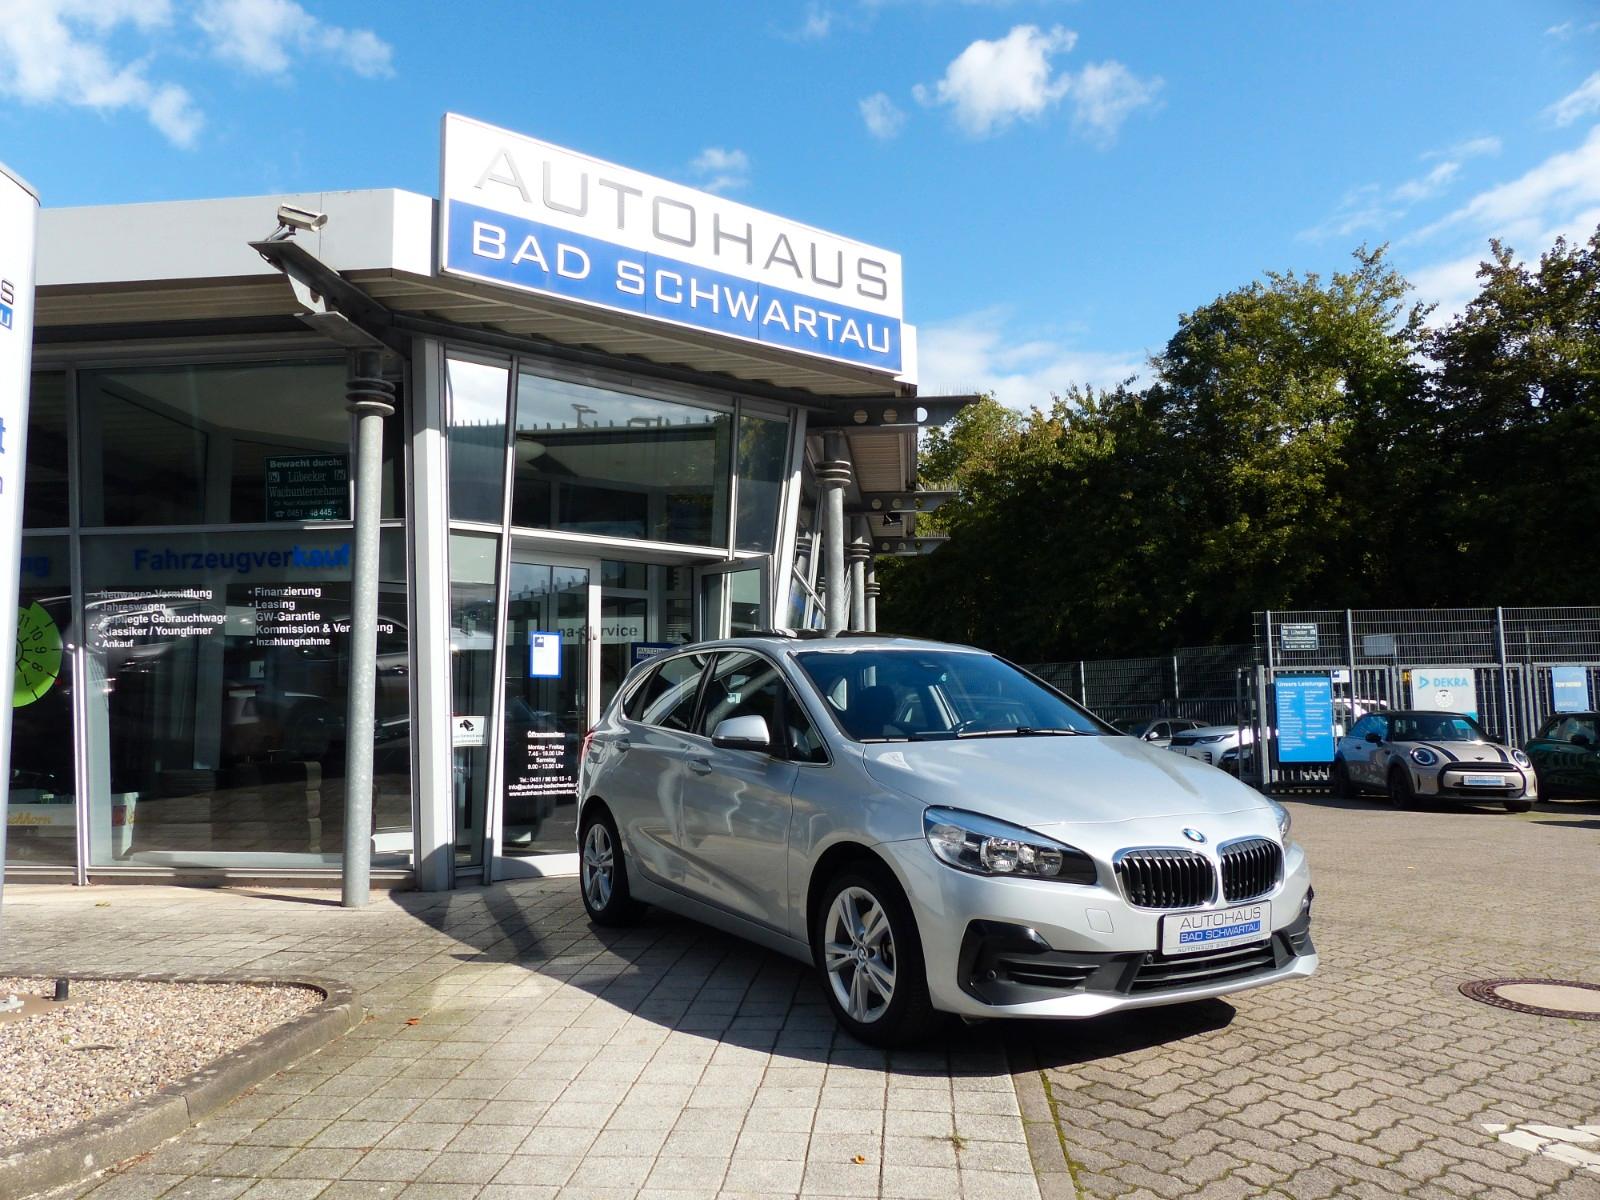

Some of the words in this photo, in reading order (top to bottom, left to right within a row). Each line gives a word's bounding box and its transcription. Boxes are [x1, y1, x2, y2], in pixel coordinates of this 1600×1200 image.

[473, 147, 888, 301] AUTOHAUS
[472, 221, 591, 281] BAD
[615, 261, 890, 354] SCHWARTAU
[133, 544, 350, 574] Fahrzeugverkauf
[100, 589, 213, 600] Neuwagen-Vermittlung
[254, 587, 322, 597] Finanzierung
[101, 603, 166, 613] Jahreswagen
[255, 600, 296, 610] Leasing
[151, 613, 228, 625] Gebrauchtwage
[255, 611, 321, 621] GW-Garantie
[155, 626, 213, 638] Youngtimer
[256, 624, 320, 634] Kommission
[322, 624, 331, 633] &
[102, 639, 134, 648] Ankauf
[256, 637, 331, 648] Inzahlungnahme
[1433, 677, 1469, 688] DEKRA
[1180, 906, 1261, 929] AUTOHAUS
[1181, 931, 1203, 942] BAD
[1205, 921, 1260, 939] SCHWARTAU
